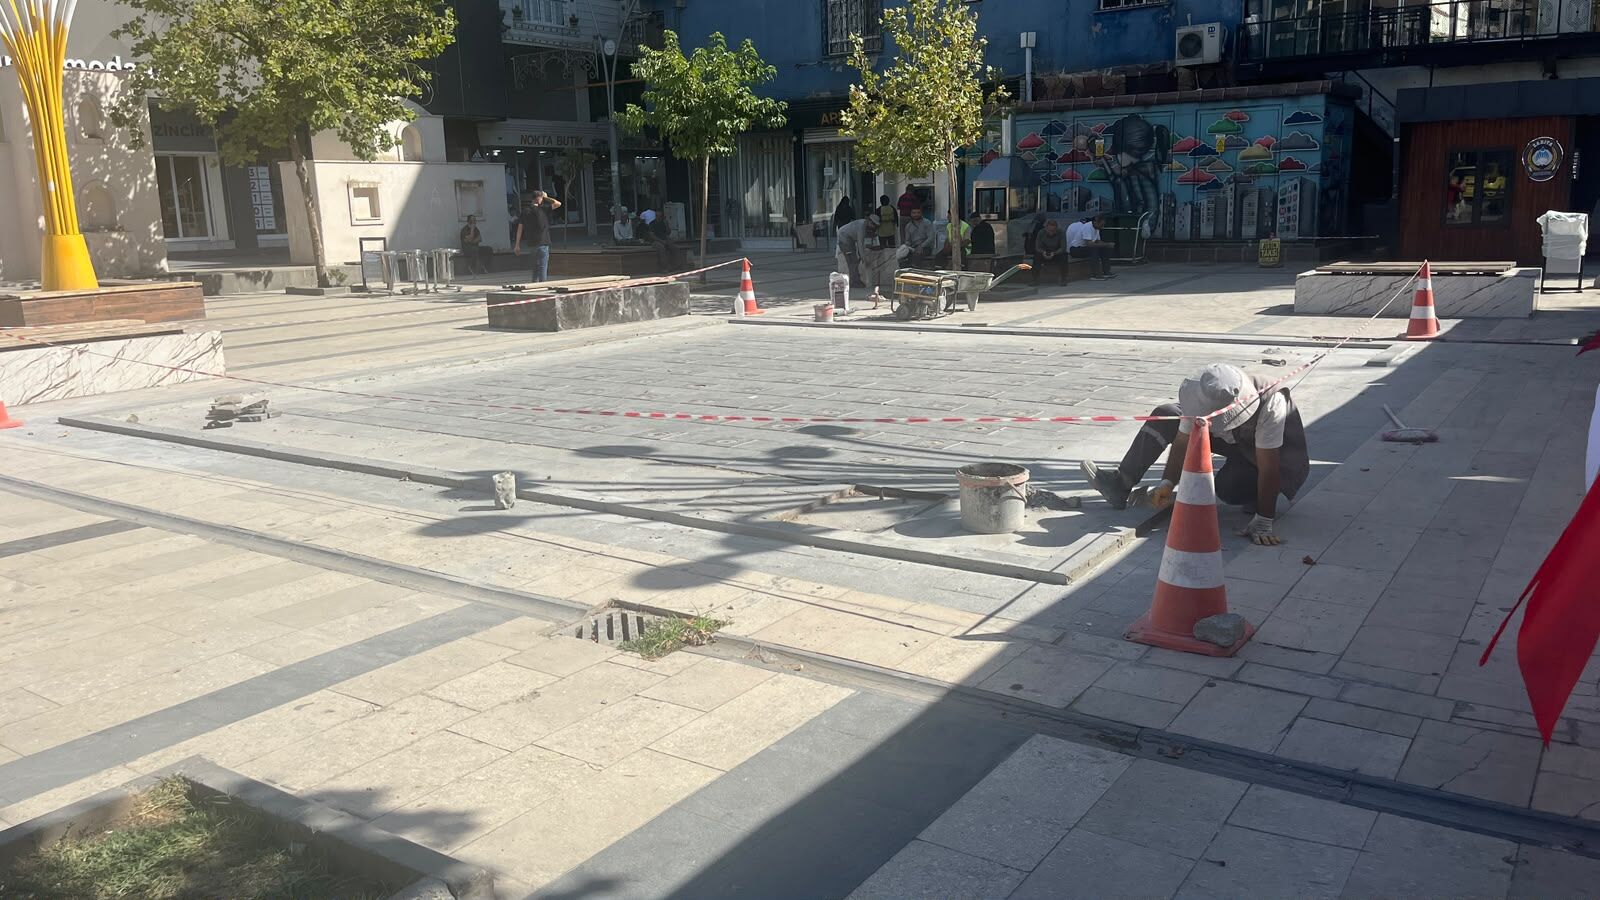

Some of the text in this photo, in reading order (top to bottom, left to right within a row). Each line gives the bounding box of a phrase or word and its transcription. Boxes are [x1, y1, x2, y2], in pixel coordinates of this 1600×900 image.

[821, 112, 842, 125] AR
[520, 134, 553, 146] NOKTA
[248, 168, 255, 177] 3
[250, 181, 257, 190] 2
[252, 193, 257, 203] 1
